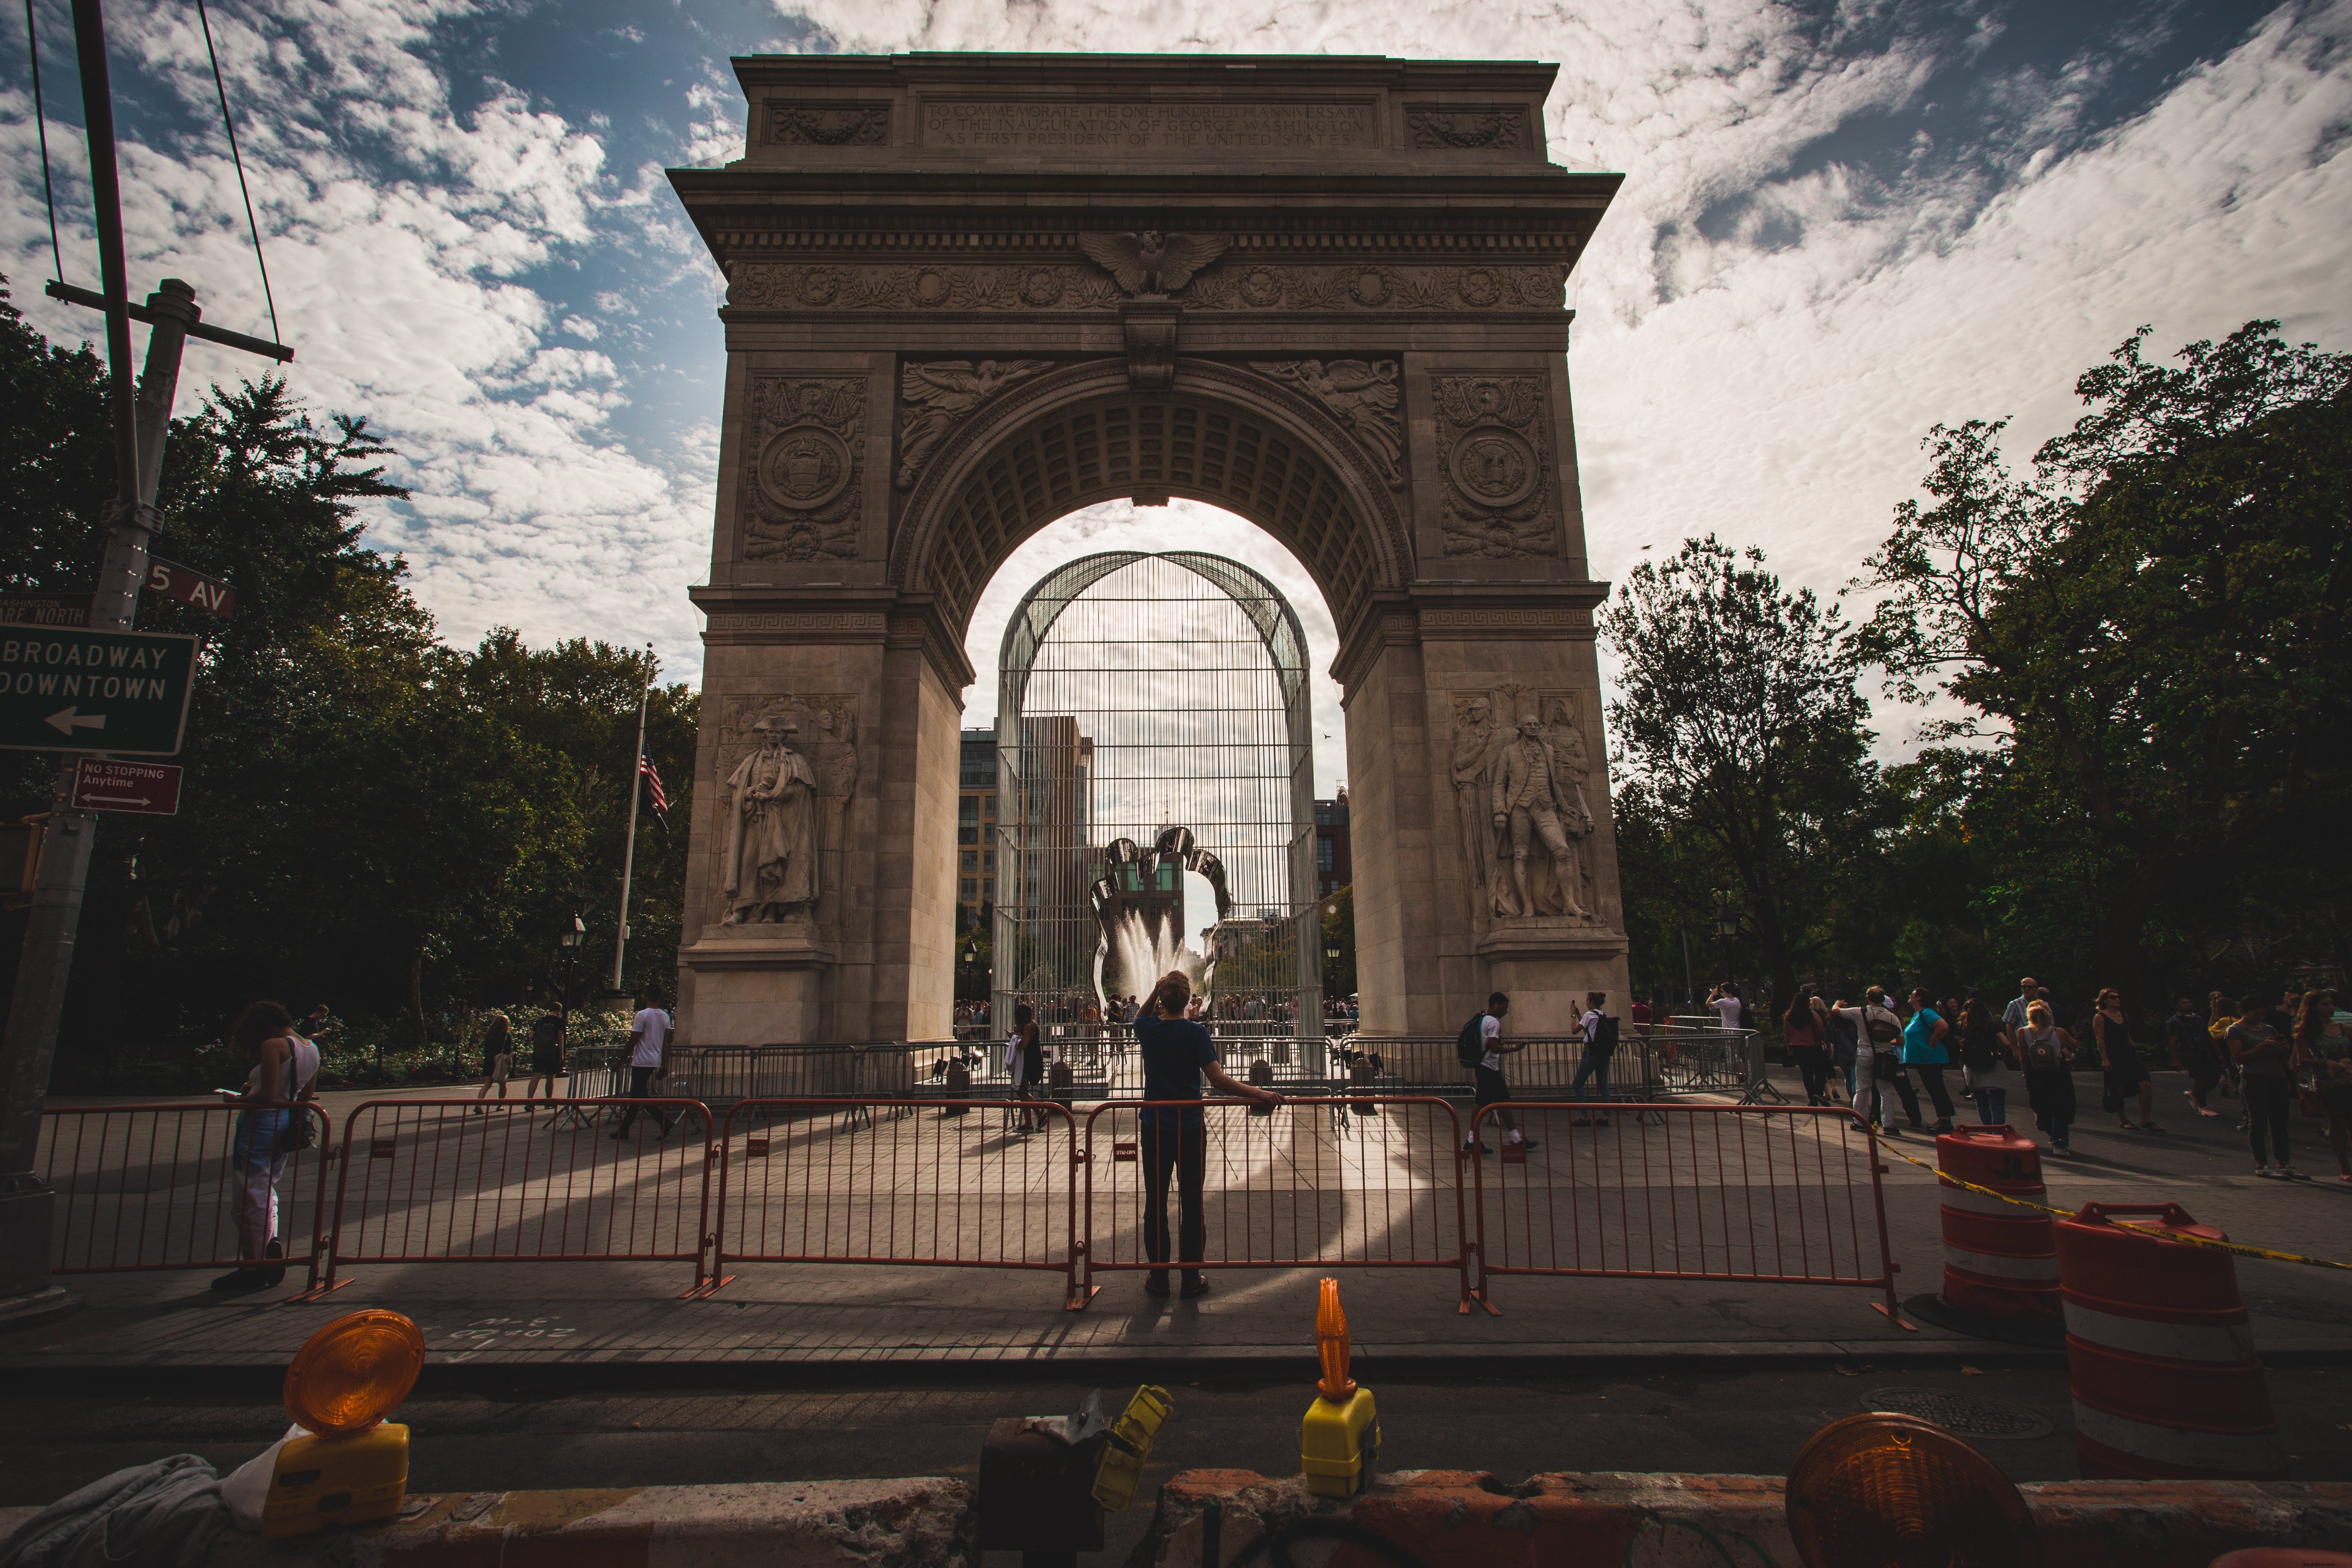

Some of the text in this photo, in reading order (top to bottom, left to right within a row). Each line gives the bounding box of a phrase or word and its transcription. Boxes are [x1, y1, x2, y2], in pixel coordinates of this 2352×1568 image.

[928, 105, 1365, 119] TO COMMEMORATE THE ONE HUNDREDTH ANNIVERSARY
[929, 119, 1364, 132] OF THE INAUGURATION OF GEORGE WASHINGTON
[943, 133, 965, 144] AS
[974, 133, 1022, 144] FIRST
[1028, 133, 1121, 145] PRESIDENT
[1129, 134, 1152, 145] OF
[1162, 134, 1198, 145] THE
[1207, 134, 1271, 145] UNITED
[961, 334, 1020, 343] ERECTED
[1026, 334, 1041, 343] BY
[1076, 335, 1121, 343] PEOPLE
[1226, 334, 1257, 343] CITY
[1280, 334, 1309, 342] NEW
[1314, 334, 1348, 342] YORK
[150, 564, 227, 610] 5 AV
[0, 599, 61, 608] ASHINGTON
[34, 608, 85, 624] NORTH
[2, 640, 168, 670] BROADWAY
[0, 671, 165, 700] DOWNTOWN
[84, 763, 165, 779] NO STOPPING
[83, 775, 134, 787] Anytime
